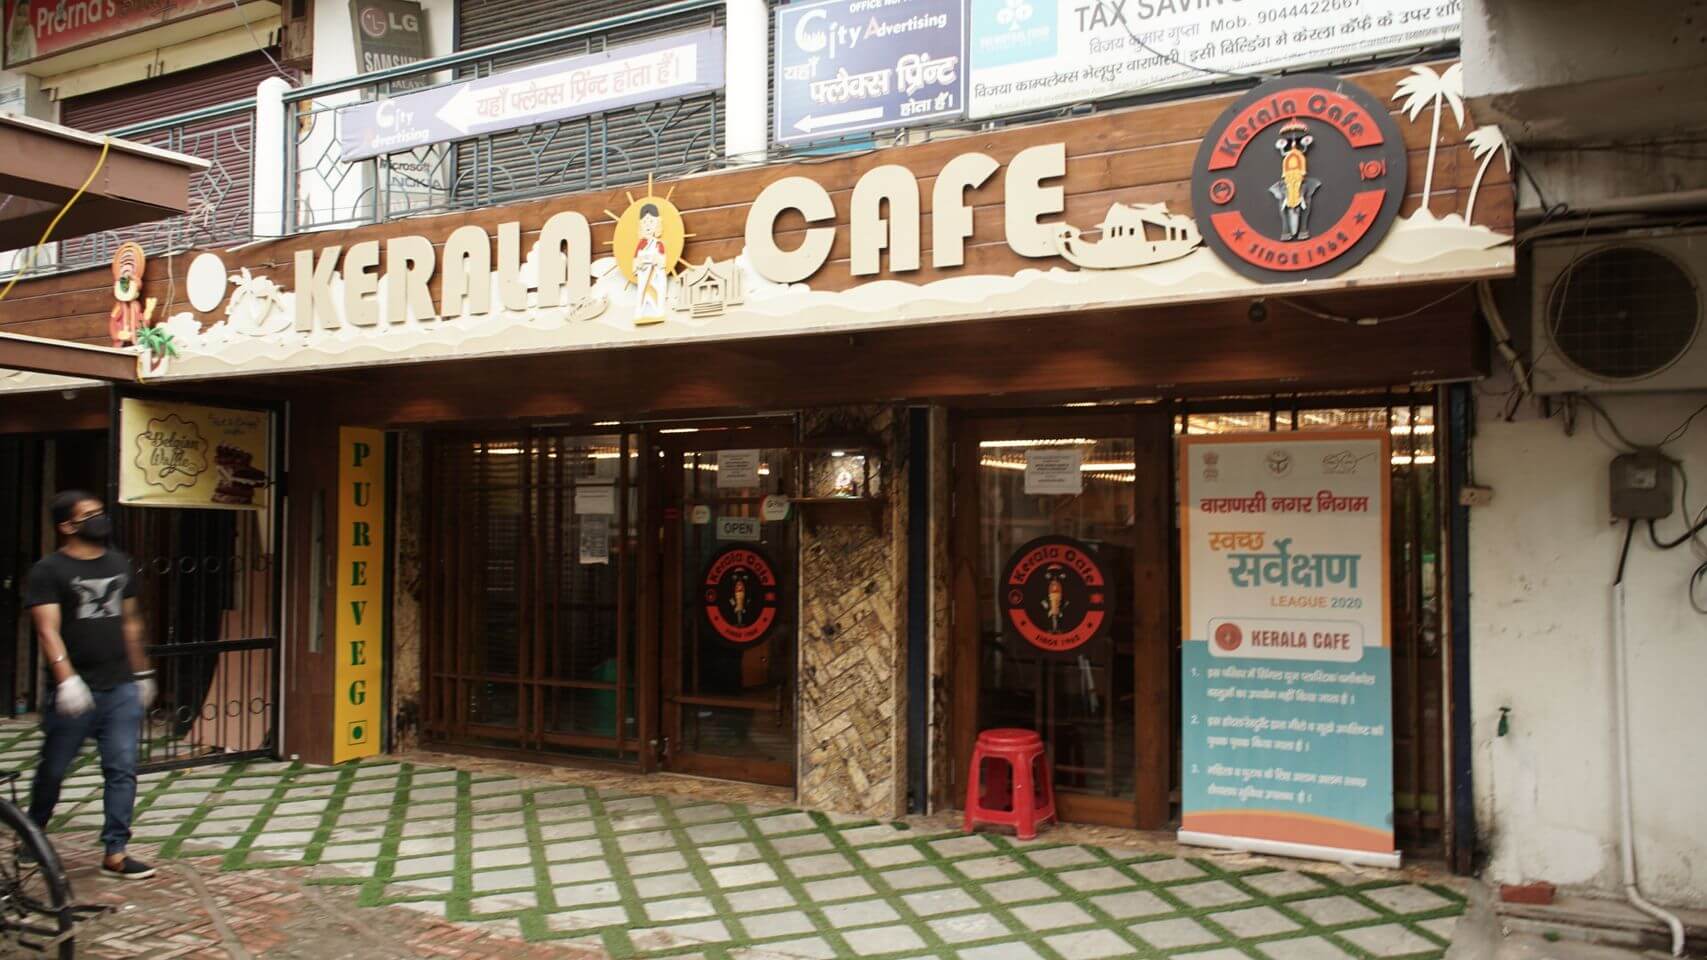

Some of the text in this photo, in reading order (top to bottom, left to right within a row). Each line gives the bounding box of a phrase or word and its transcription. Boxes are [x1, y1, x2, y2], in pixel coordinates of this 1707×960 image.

[388, 12, 419, 32] LG
[1074, 0, 1127, 32] TAX
[794, 9, 862, 59] City
[864, 13, 947, 40] Advertising
[613, 62, 652, 93] होता
[375, 102, 415, 132] City
[1220, 94, 1367, 158] Kerala Cafe
[294, 142, 1067, 333] KERALA CAFE
[1200, 489, 1369, 514] वाराणसी नगर निगम
[723, 522, 753, 535] OPEN
[1208, 531, 1266, 551] स्वच्छ
[1015, 547, 1059, 583] Kerala
[1227, 537, 1361, 588] सर्वेक्षण
[1270, 595, 1362, 609] LEAGUE 2020
[1251, 630, 1350, 650] KERALA CAFE
